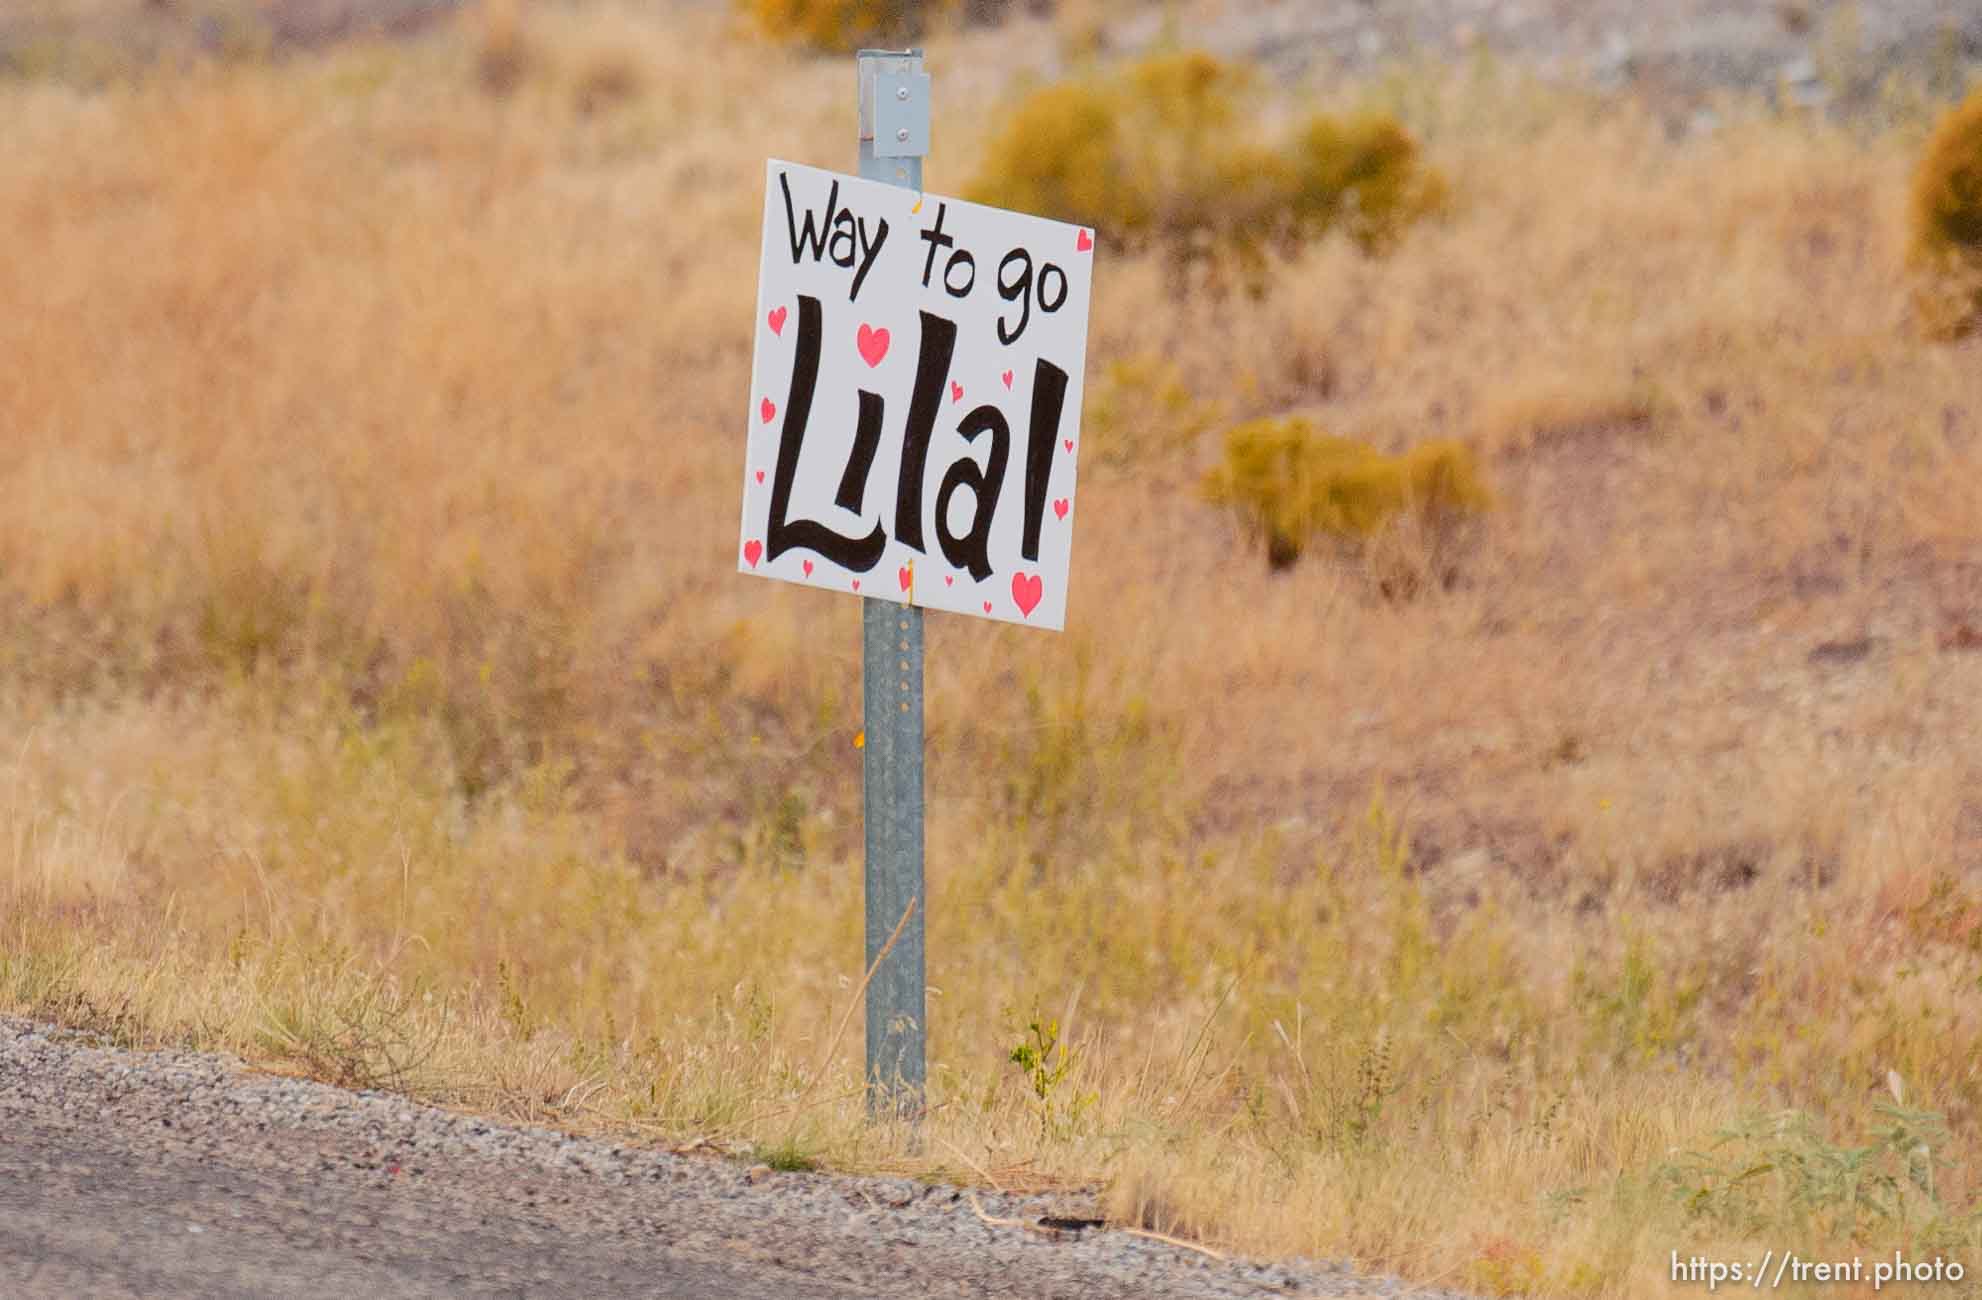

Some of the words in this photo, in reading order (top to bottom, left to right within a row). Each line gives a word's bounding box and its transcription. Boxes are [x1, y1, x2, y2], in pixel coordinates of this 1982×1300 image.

[779, 171, 889, 302] Way
[920, 203, 976, 298] to
[997, 247, 1069, 345] go
